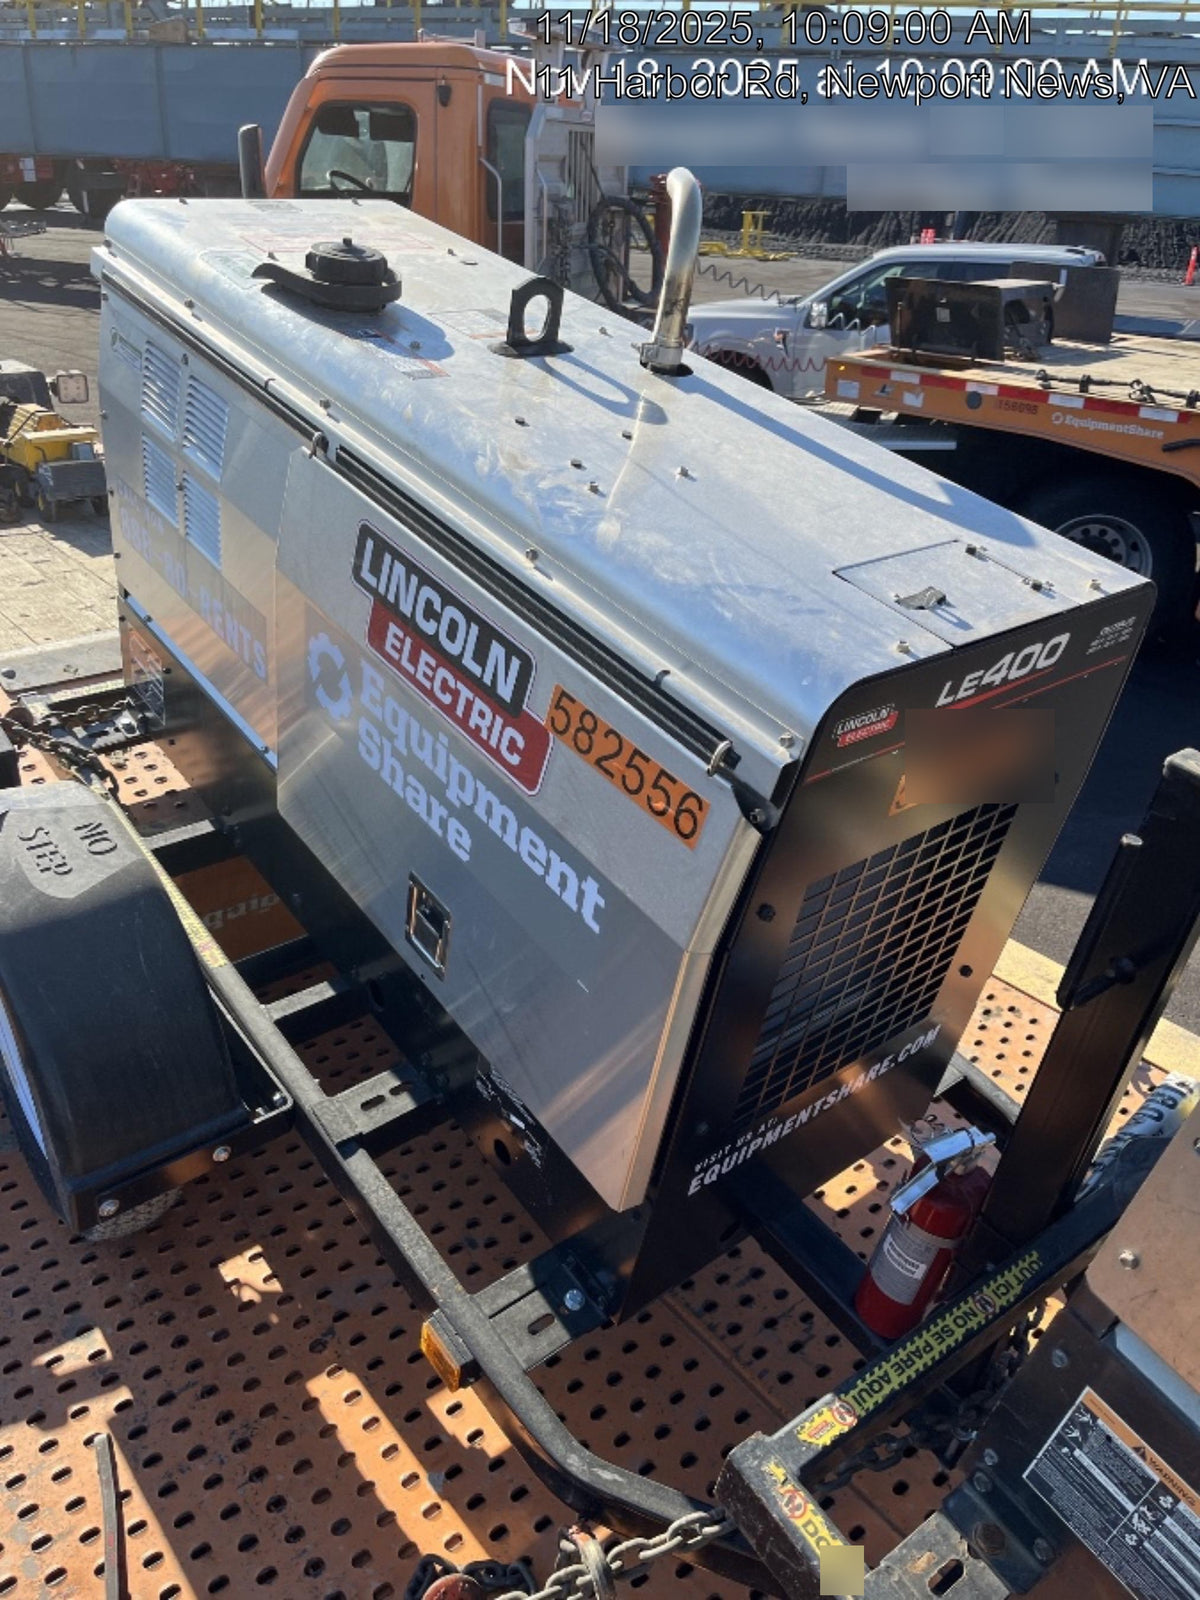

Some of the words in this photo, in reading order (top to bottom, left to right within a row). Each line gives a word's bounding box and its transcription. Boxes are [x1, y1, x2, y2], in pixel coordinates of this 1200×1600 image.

[1064, 415, 1164, 439] EquipmentShare
[360, 536, 521, 704] LINCOLN
[935, 632, 1071, 708] LE400
[384, 624, 527, 767] ELECTRIC
[837, 707, 890, 735] LINCOLN
[550, 688, 706, 842] 582556
[358, 719, 473, 863] Share
[358, 656, 606, 935] Equipment
[18, 826, 74, 876] STEP
[73, 821, 118, 856] NO
[687, 1023, 942, 1197] EQUIPMENTSHARE.COM
[932, 1323, 955, 1347] SE
[952, 1305, 978, 1329] NO
[890, 1340, 934, 1376] PARE
[1149, 1457, 1197, 1507] WARNING
